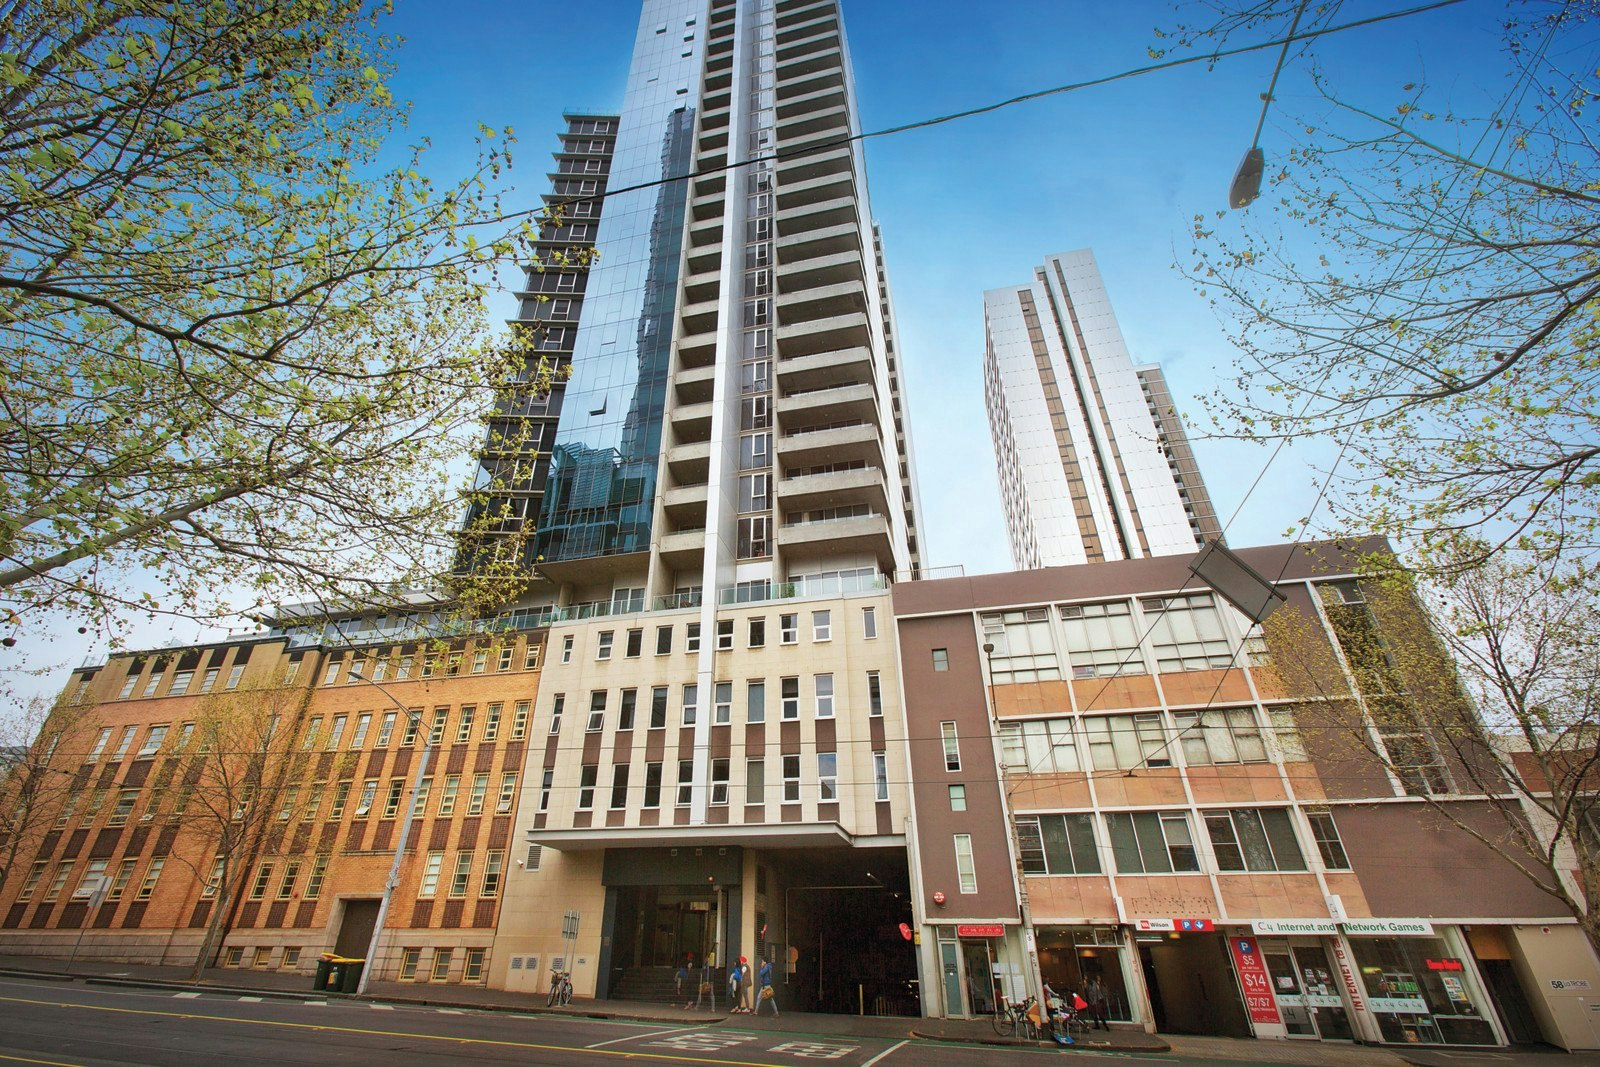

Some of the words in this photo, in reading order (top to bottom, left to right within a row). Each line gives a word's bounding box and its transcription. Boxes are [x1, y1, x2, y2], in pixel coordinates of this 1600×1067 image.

[1277, 923, 1315, 932] Internet
[1317, 923, 1336, 932] and
[1345, 923, 1386, 932] Network
[1389, 923, 1425, 932] Games
[1242, 955, 1255, 965] $5
[1245, 974, 1266, 987] $14
[1551, 980, 1564, 989] 58
[1340, 964, 1365, 1011] INTERNET
[1248, 997, 1270, 1007] $7/$7
